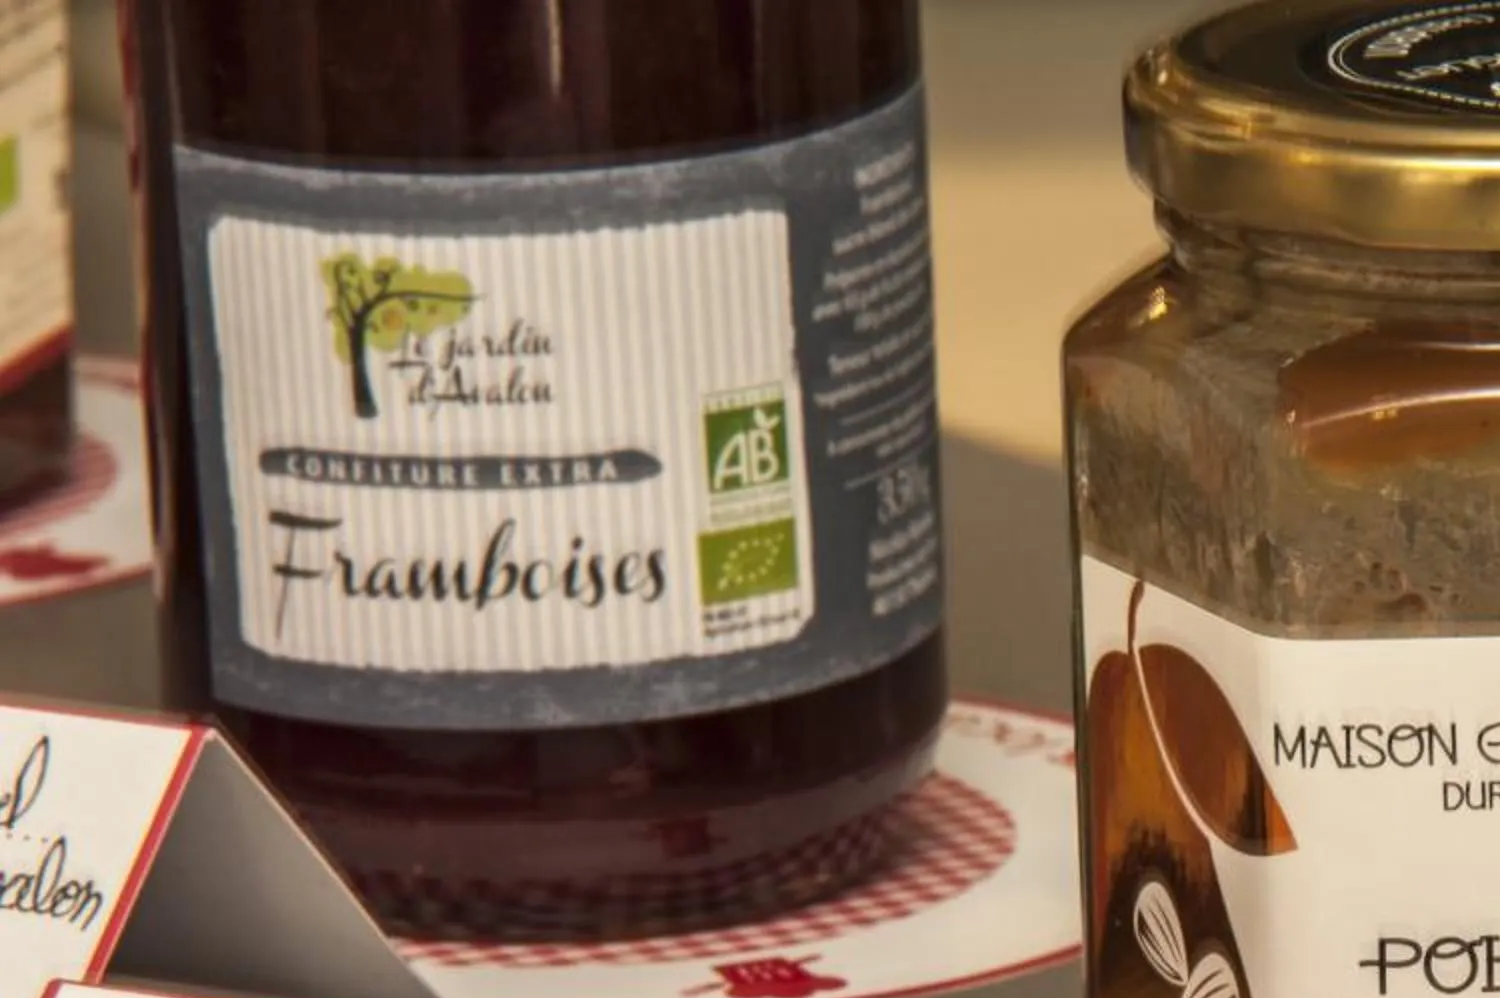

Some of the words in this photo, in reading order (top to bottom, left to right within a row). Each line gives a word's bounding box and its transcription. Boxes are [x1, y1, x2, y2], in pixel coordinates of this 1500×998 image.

[438, 318, 552, 371] jardin
[285, 455, 480, 487] CONFITURE
[501, 457, 620, 486] EXTRA
[268, 510, 665, 641] Framboises
[1273, 722, 1458, 769] MAISON
